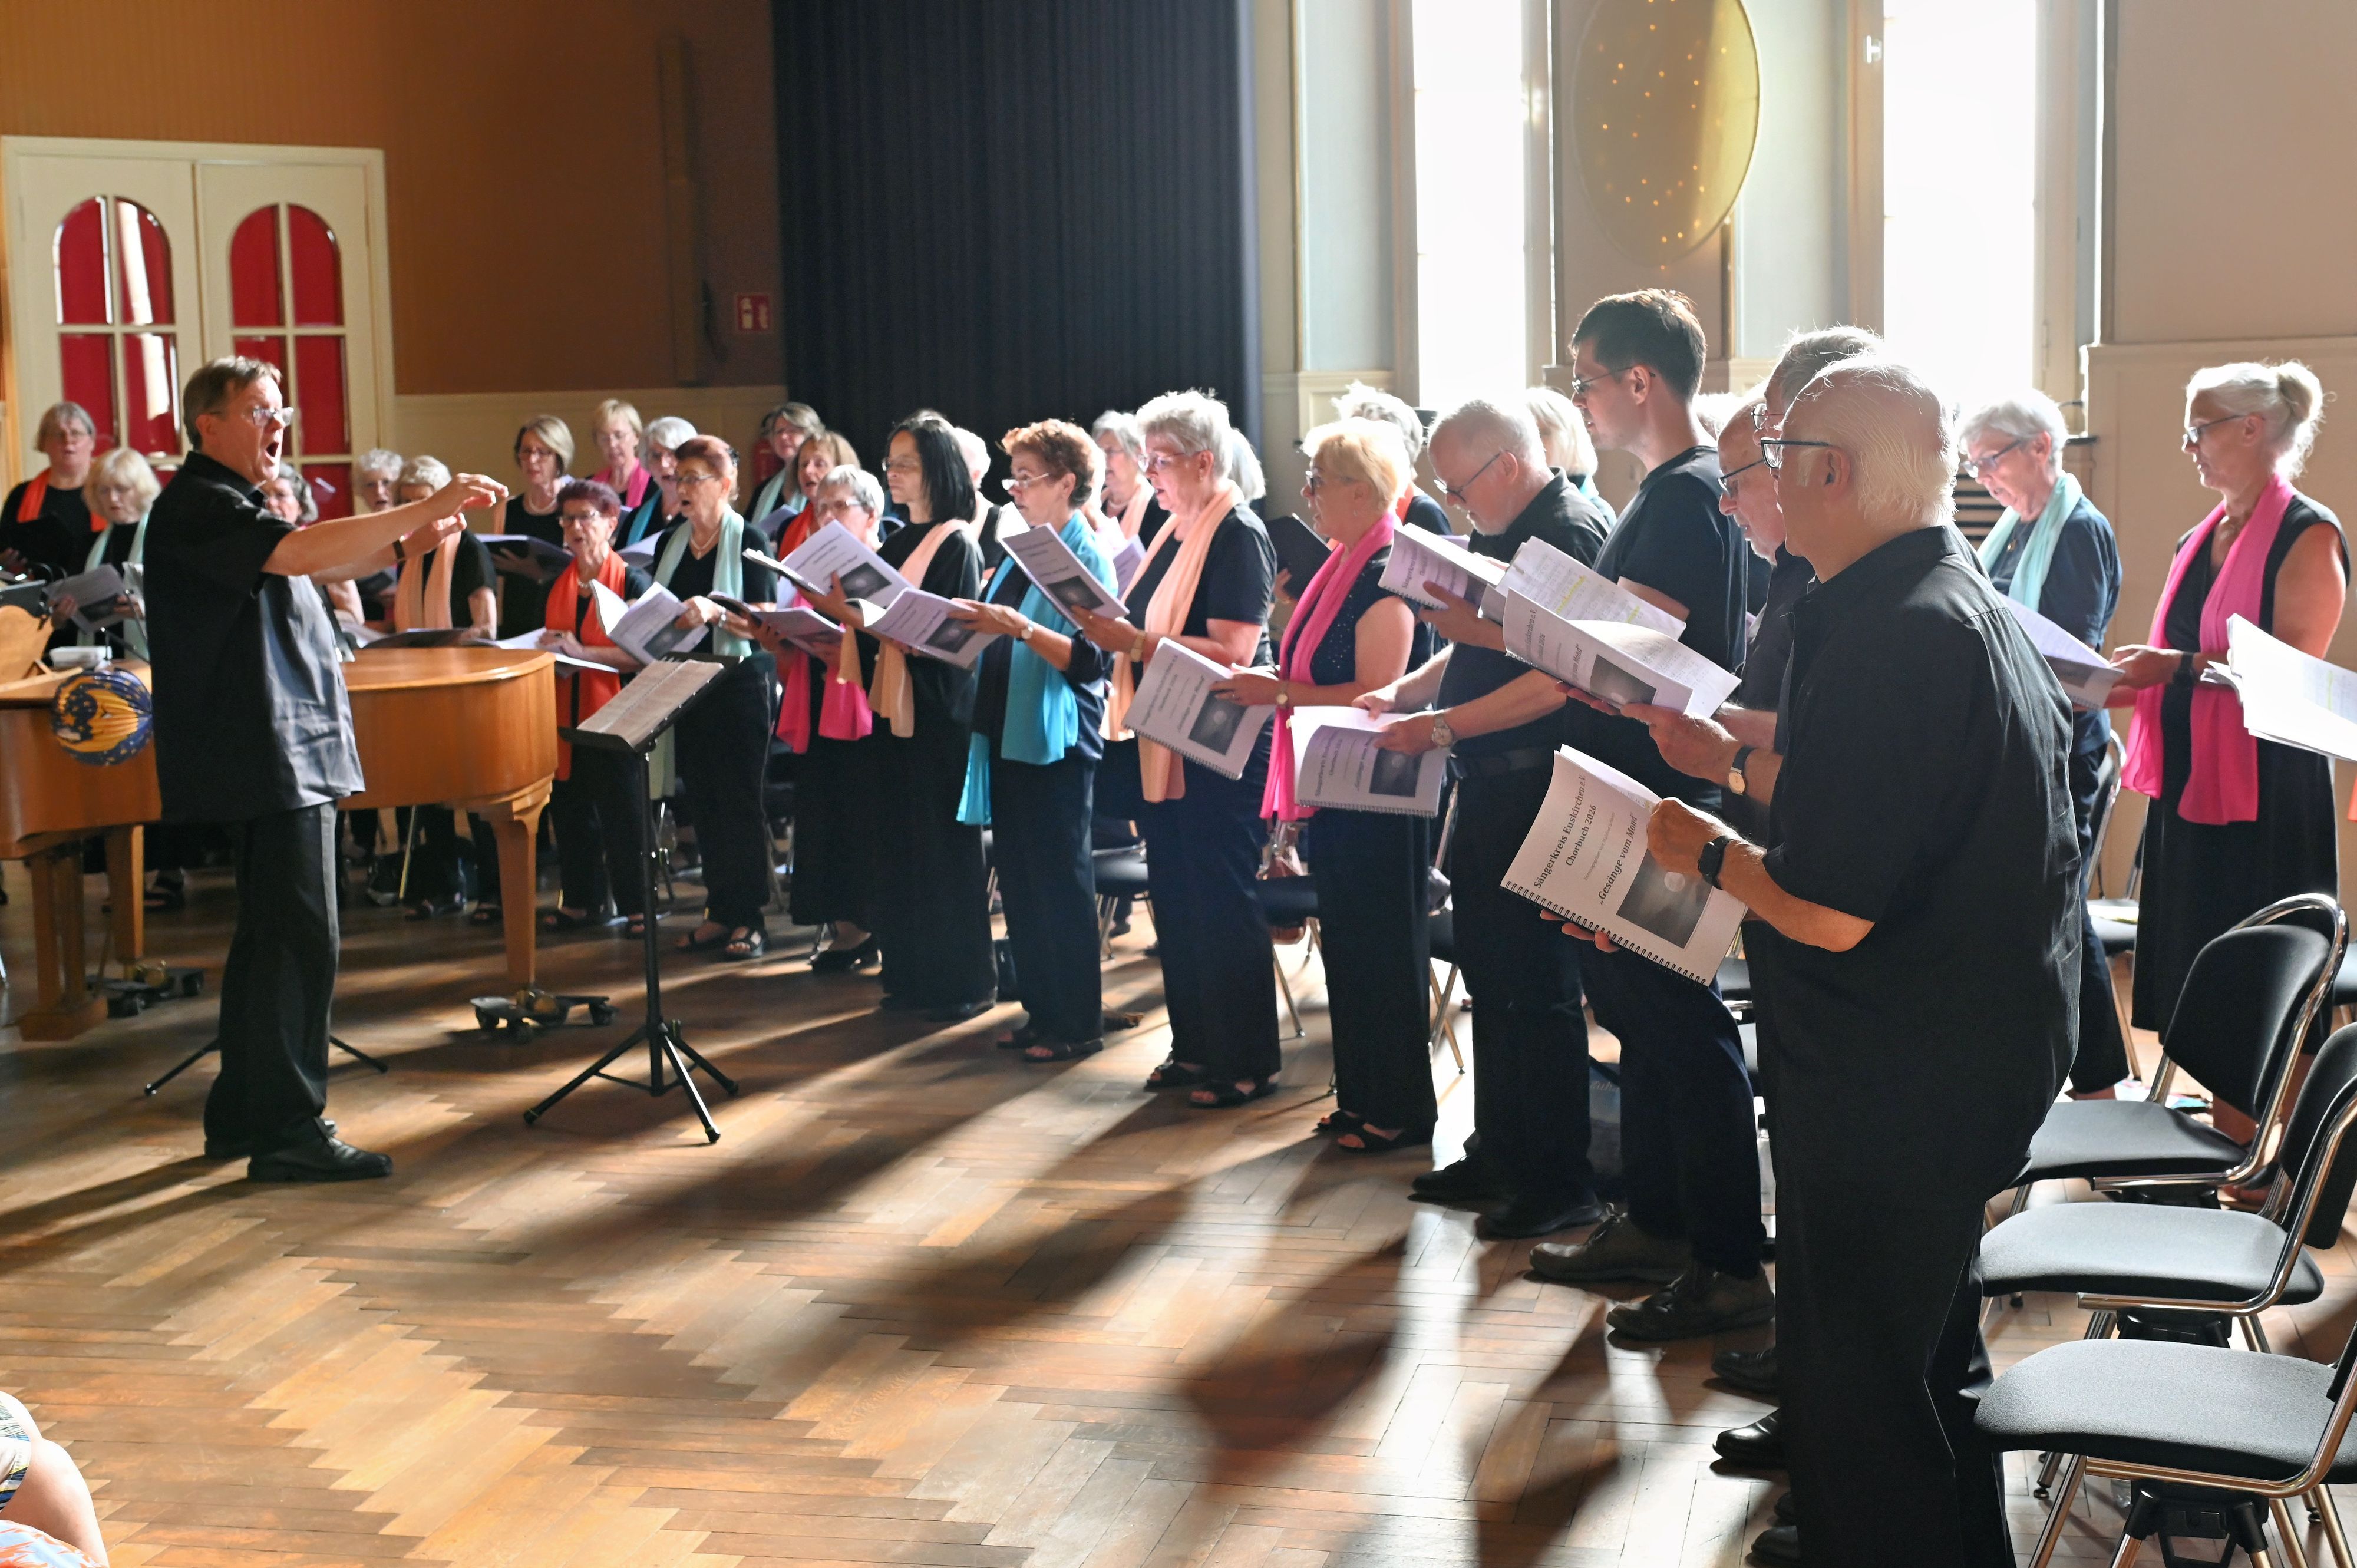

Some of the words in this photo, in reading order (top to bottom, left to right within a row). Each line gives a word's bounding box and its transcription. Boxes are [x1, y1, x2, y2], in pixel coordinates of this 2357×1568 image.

[1534, 835, 1567, 889] Sängerkreis
[1563, 786, 1585, 835] Euskirchen
[1566, 826, 1590, 866] Chorbuch
[1584, 805, 1596, 826] 2026
[1619, 839, 1632, 859] vom
